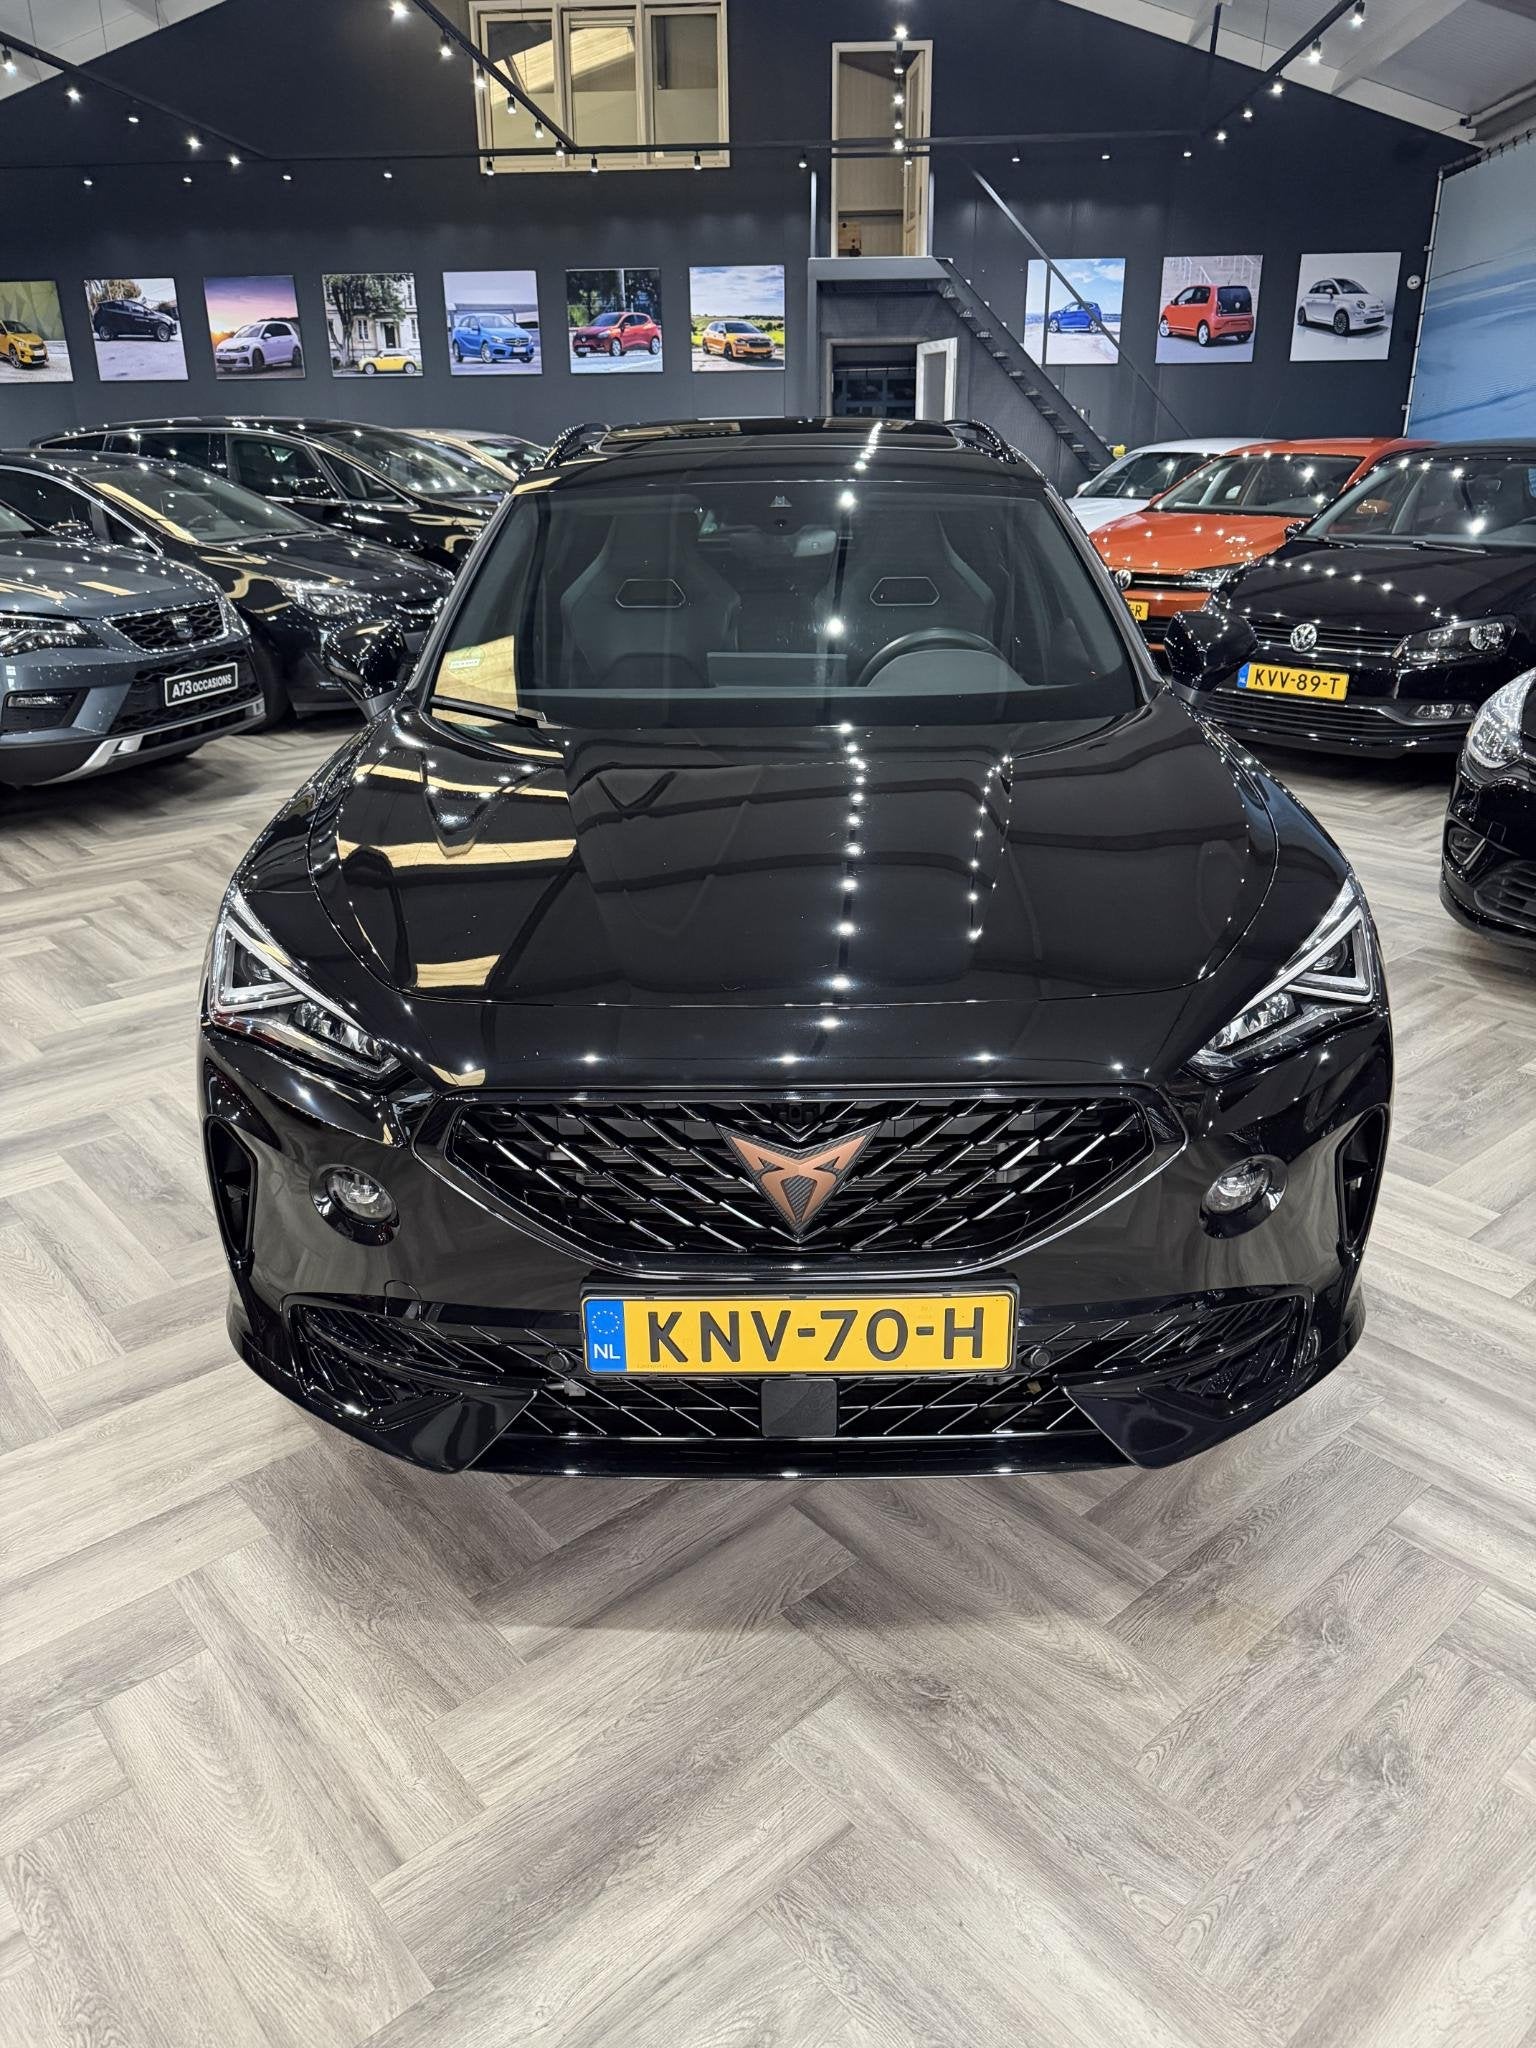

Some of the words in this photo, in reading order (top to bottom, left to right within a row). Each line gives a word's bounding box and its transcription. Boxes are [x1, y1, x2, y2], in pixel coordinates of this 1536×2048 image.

[172, 680, 192, 698] A73
[193, 674, 232, 692] OCCASIONS
[1255, 669, 1340, 694] KVV-89-T
[648, 1307, 984, 1362] KNV-70-H
[594, 1344, 620, 1359] NL
